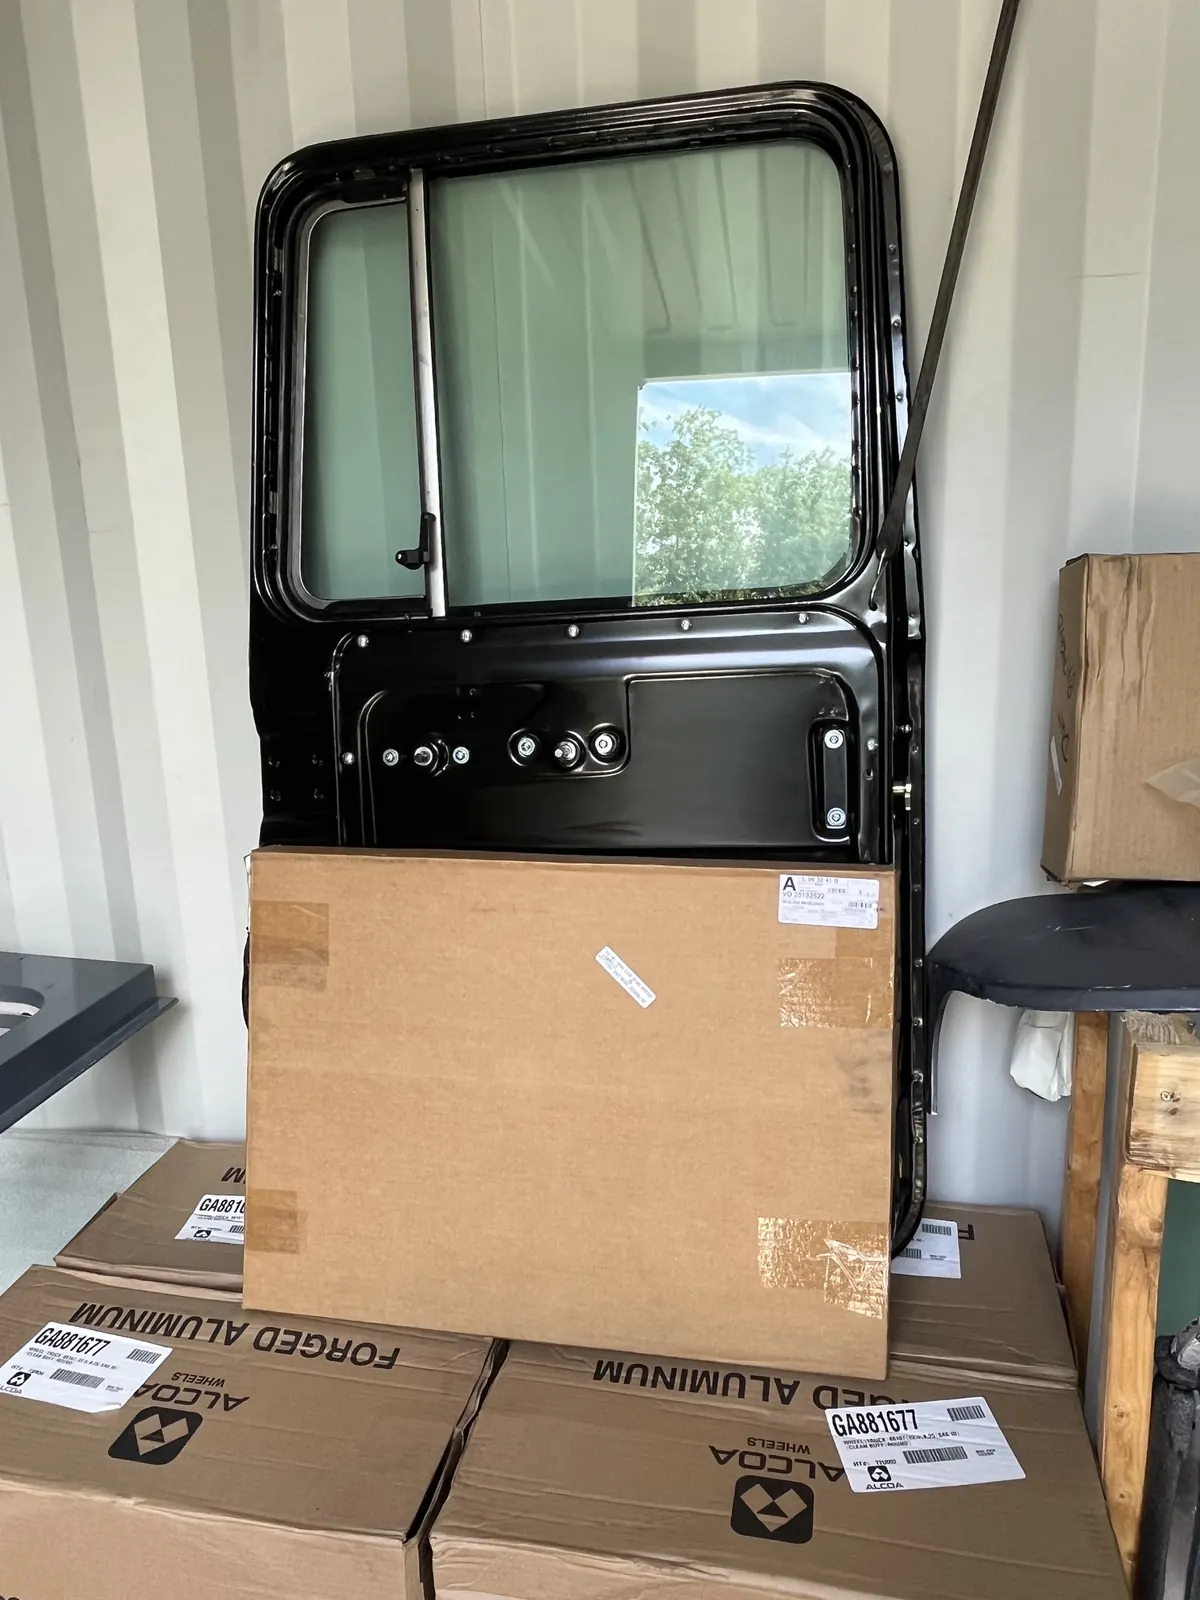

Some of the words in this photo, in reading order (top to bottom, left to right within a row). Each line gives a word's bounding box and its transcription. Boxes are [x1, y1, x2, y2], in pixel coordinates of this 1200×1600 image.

[783, 876, 796, 891] A
[68, 1302, 250, 1346] ALUMINUM
[34, 1328, 111, 1356] GA881677
[252, 1326, 401, 1370] FORGED
[171, 1371, 226, 1388] WHEELS
[593, 1360, 800, 1406] ALUMINUM
[133, 1383, 250, 1412] ALCOA
[832, 1409, 918, 1437] GA881677
[747, 1437, 811, 1454] WHEELS
[708, 1445, 845, 1482] ALCOA
[866, 1482, 904, 1490] ALCOA
